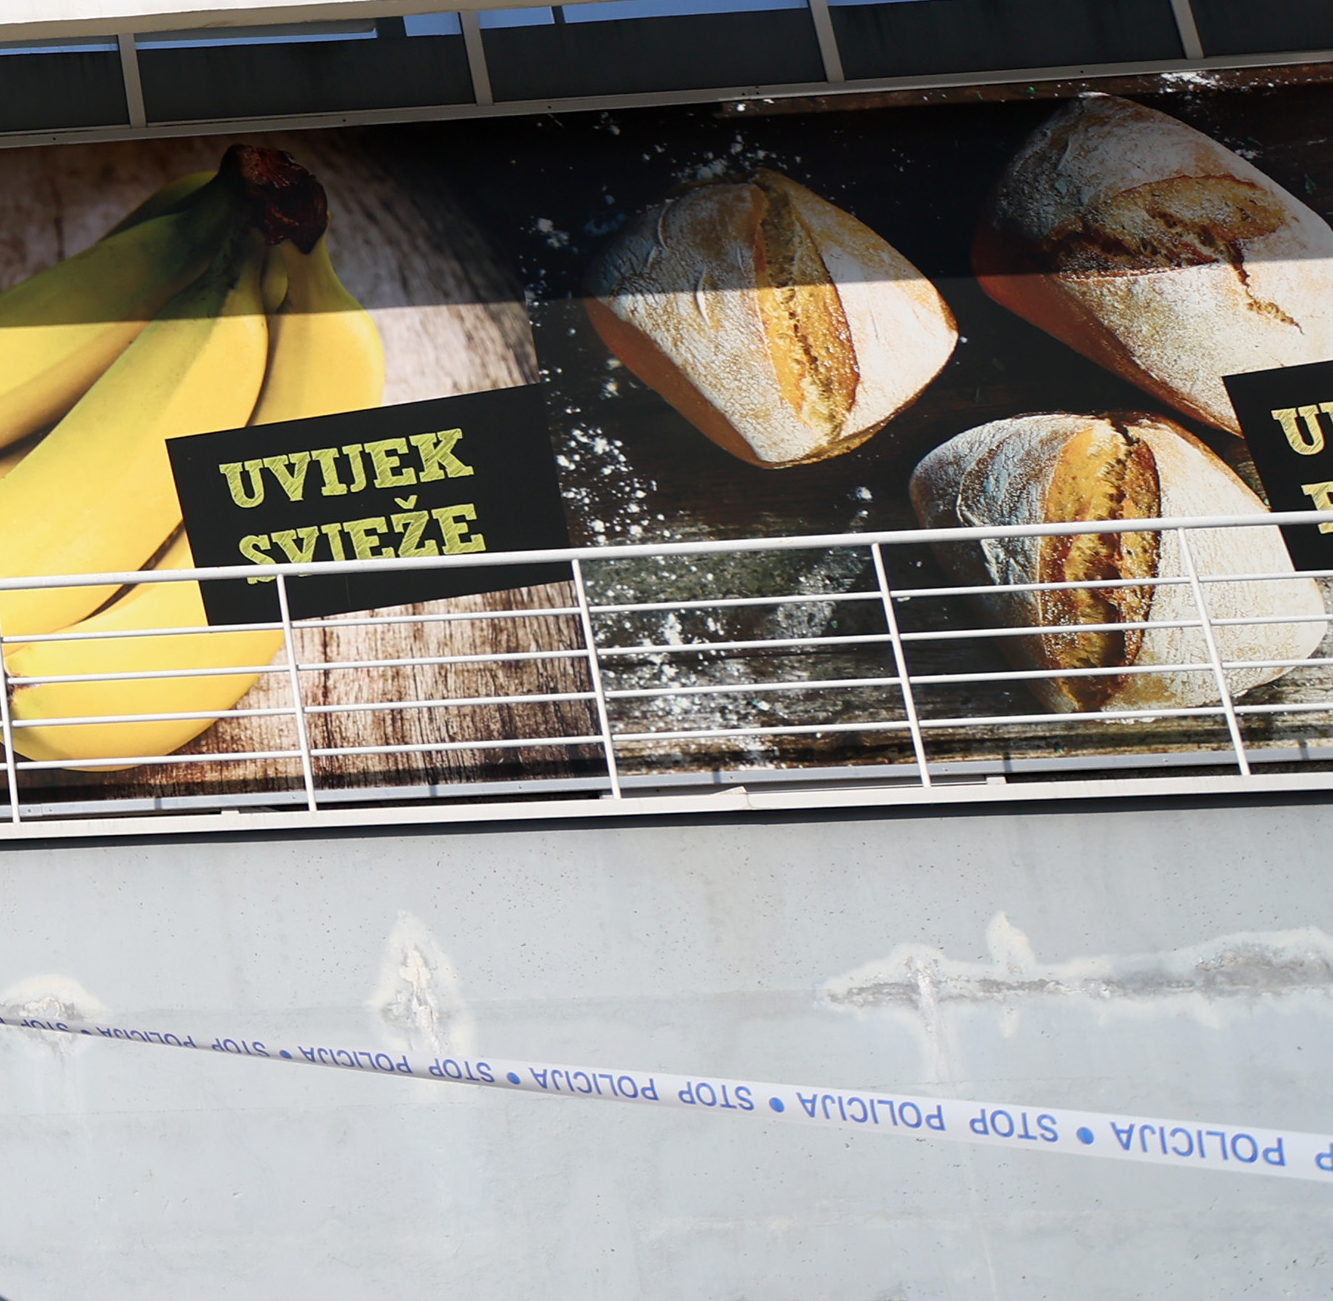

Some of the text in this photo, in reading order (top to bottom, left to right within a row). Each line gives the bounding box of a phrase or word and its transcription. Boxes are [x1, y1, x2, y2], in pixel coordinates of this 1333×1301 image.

[1271, 401, 1333, 456] U
[219, 428, 474, 508] UVIJEK
[297, 1046, 414, 1074] POLICIJA
[428, 1058, 495, 1083] STOP
[529, 1067, 660, 1101] POLICIJA
[678, 1081, 755, 1111] STOP
[796, 1092, 946, 1131] POLICIJA
[969, 1108, 1059, 1143] STOP
[1110, 1121, 1287, 1167] POLICIJA
